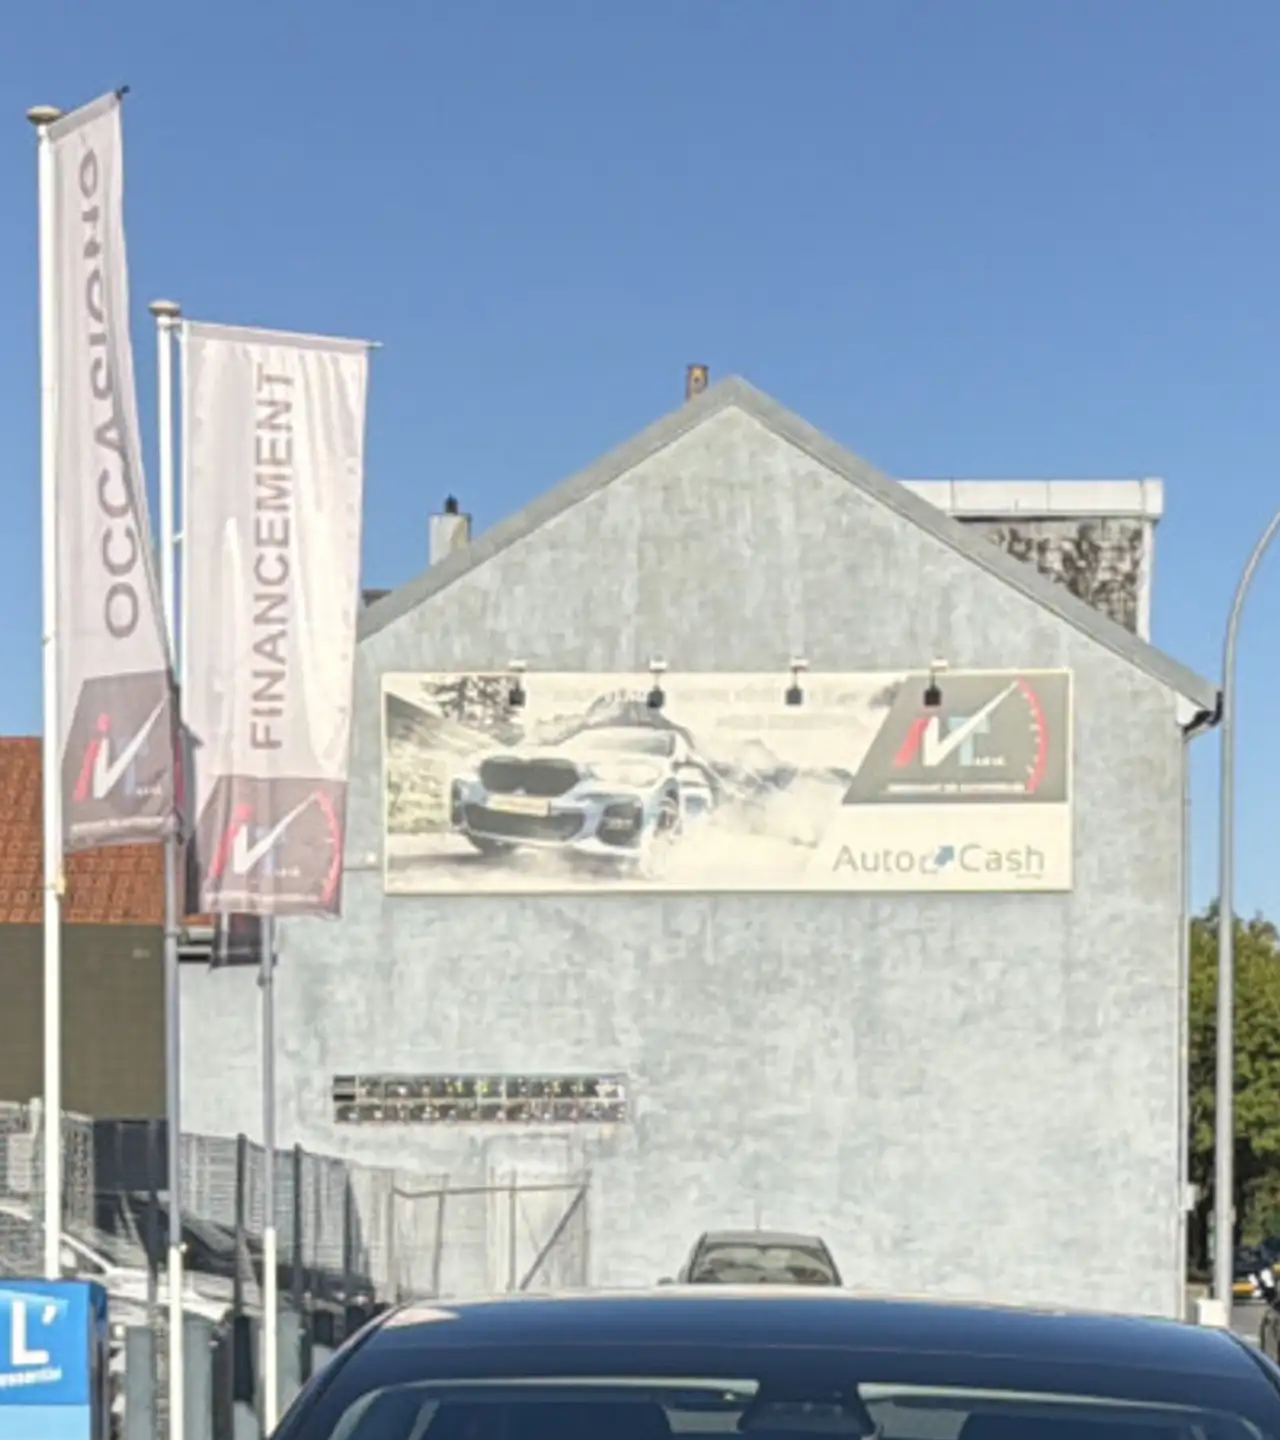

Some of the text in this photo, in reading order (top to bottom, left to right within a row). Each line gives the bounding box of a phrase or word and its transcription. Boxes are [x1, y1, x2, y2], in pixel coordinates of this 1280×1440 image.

[250, 362, 294, 751] FINANCEMENT
[832, 843, 1045, 873] Auto Cash
